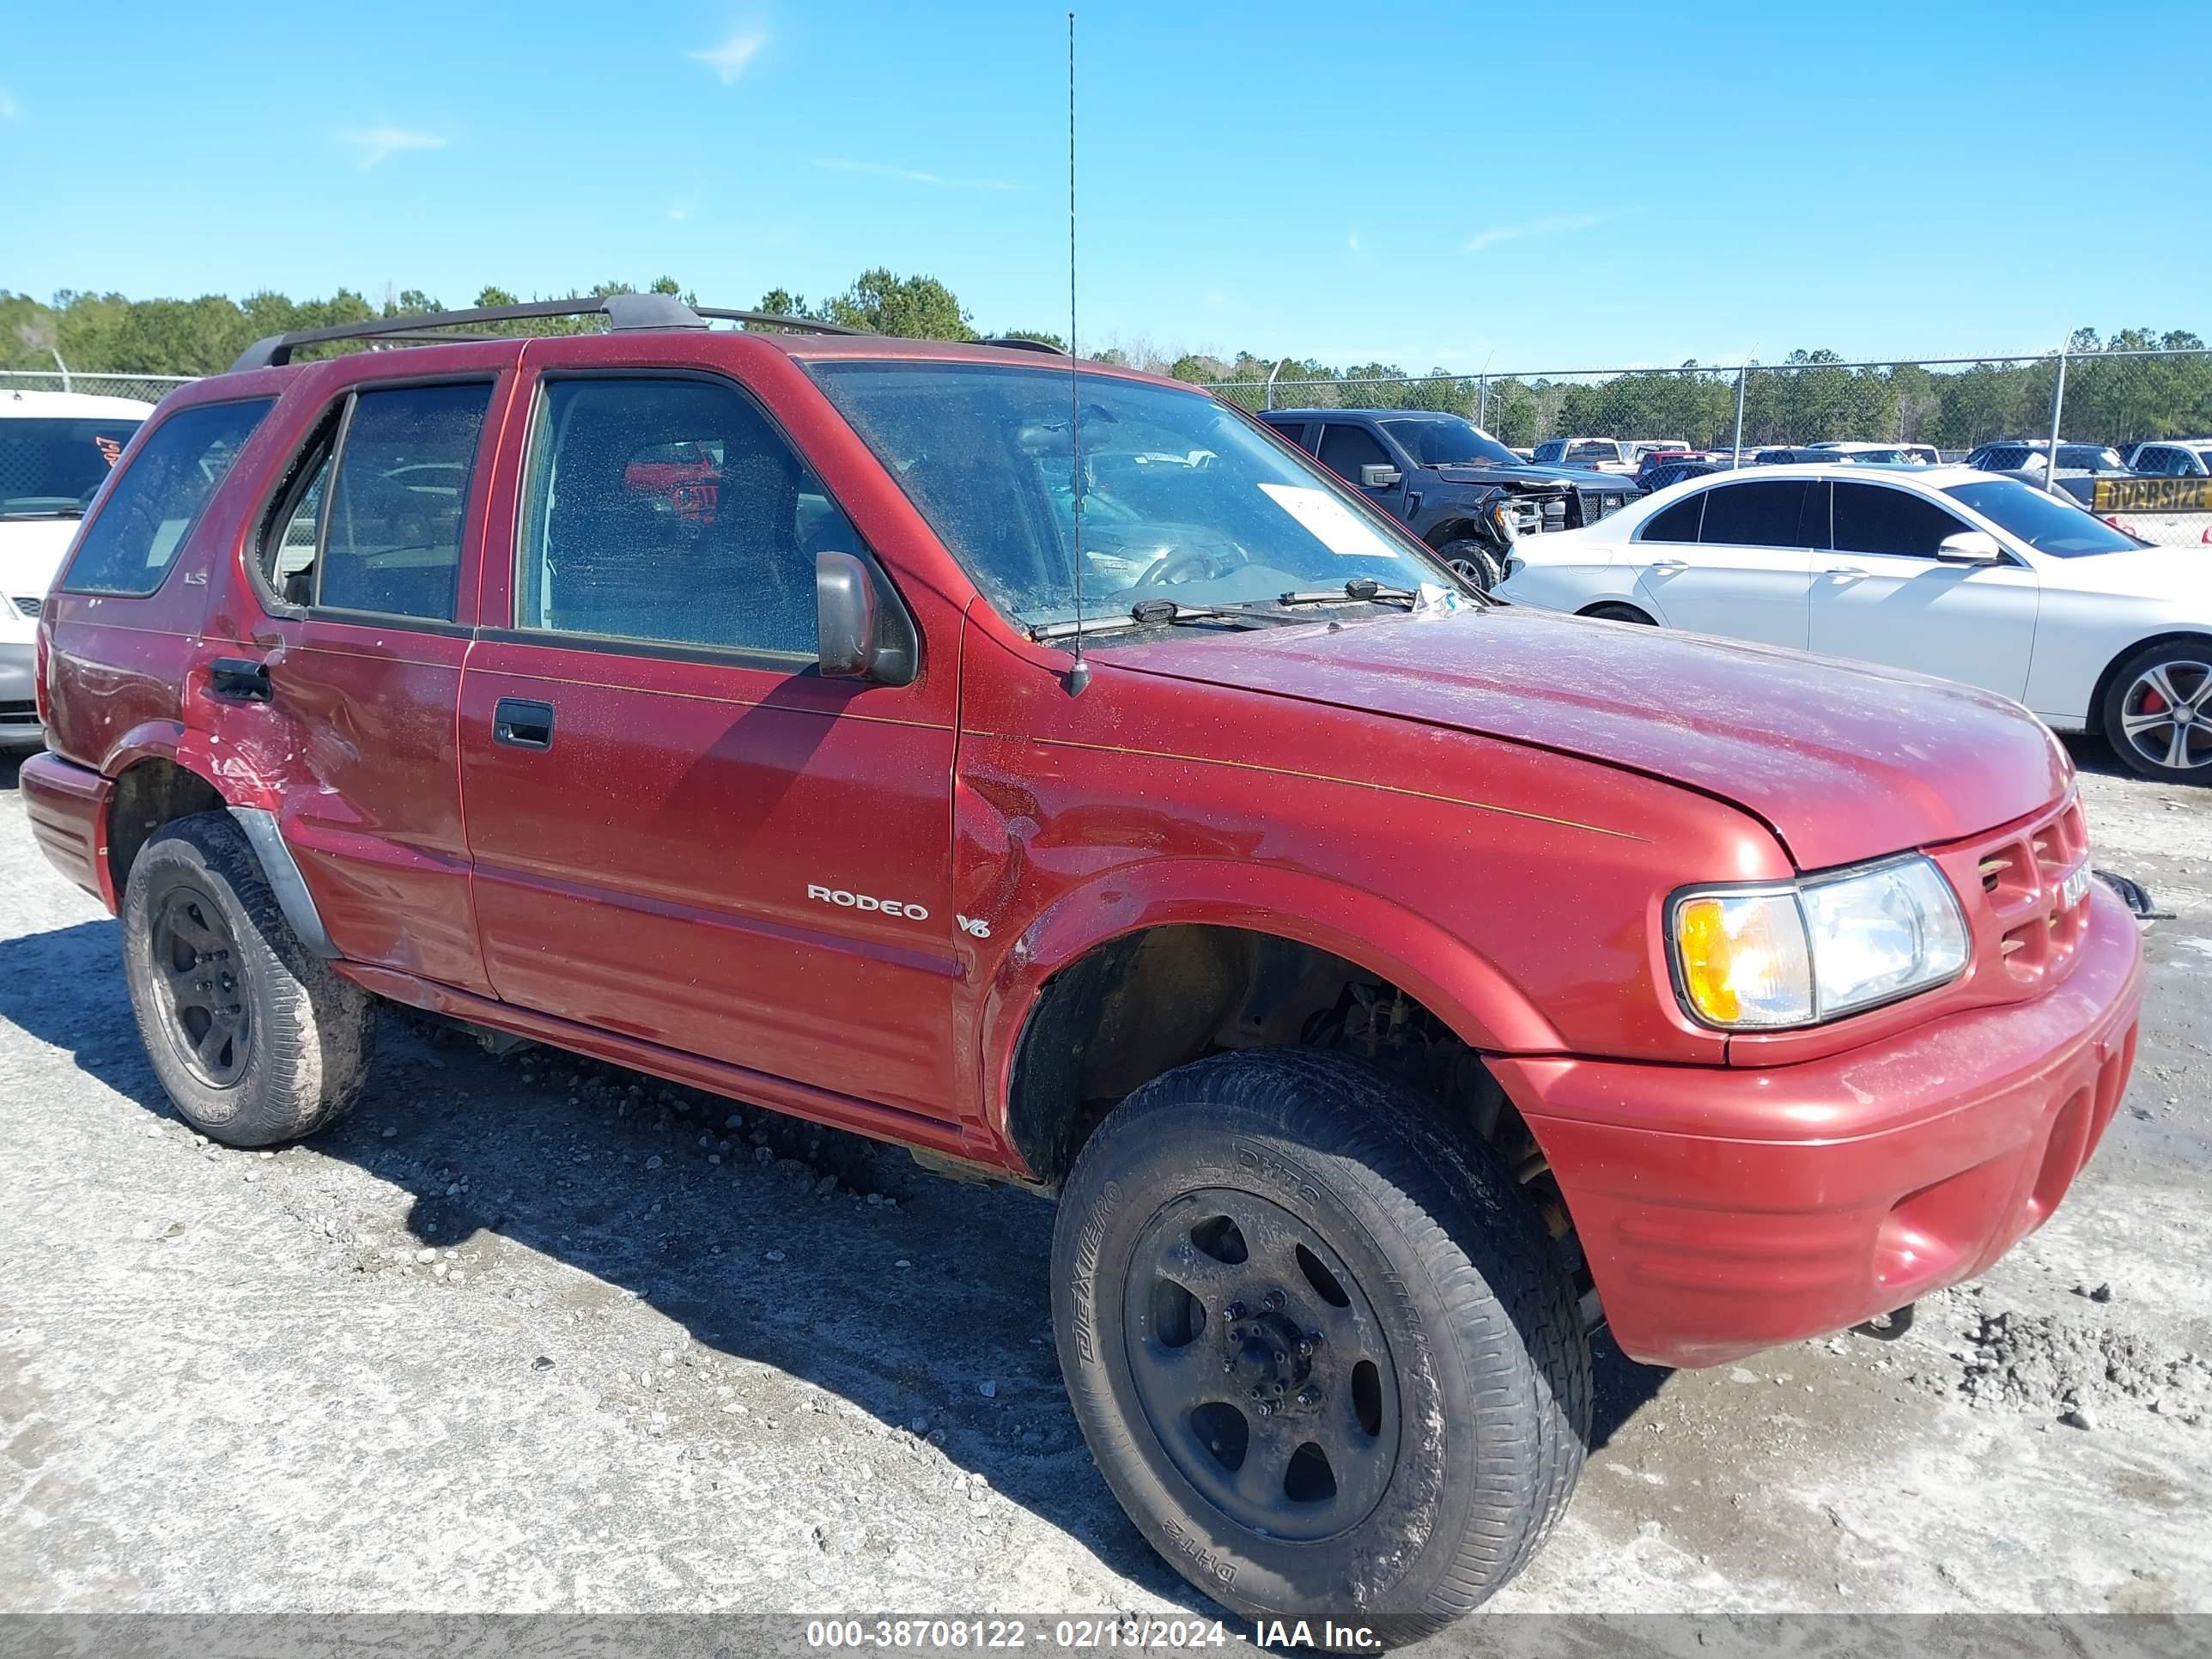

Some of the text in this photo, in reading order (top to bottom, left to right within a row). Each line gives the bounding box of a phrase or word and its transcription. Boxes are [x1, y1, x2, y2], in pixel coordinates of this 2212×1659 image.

[2106, 479, 2208, 510] OVERSIZE
[185, 572, 207, 585] LS
[807, 884, 928, 921] RODEO
[956, 914, 991, 939] V6
[1069, 1179, 1125, 1369] DEXTERO
